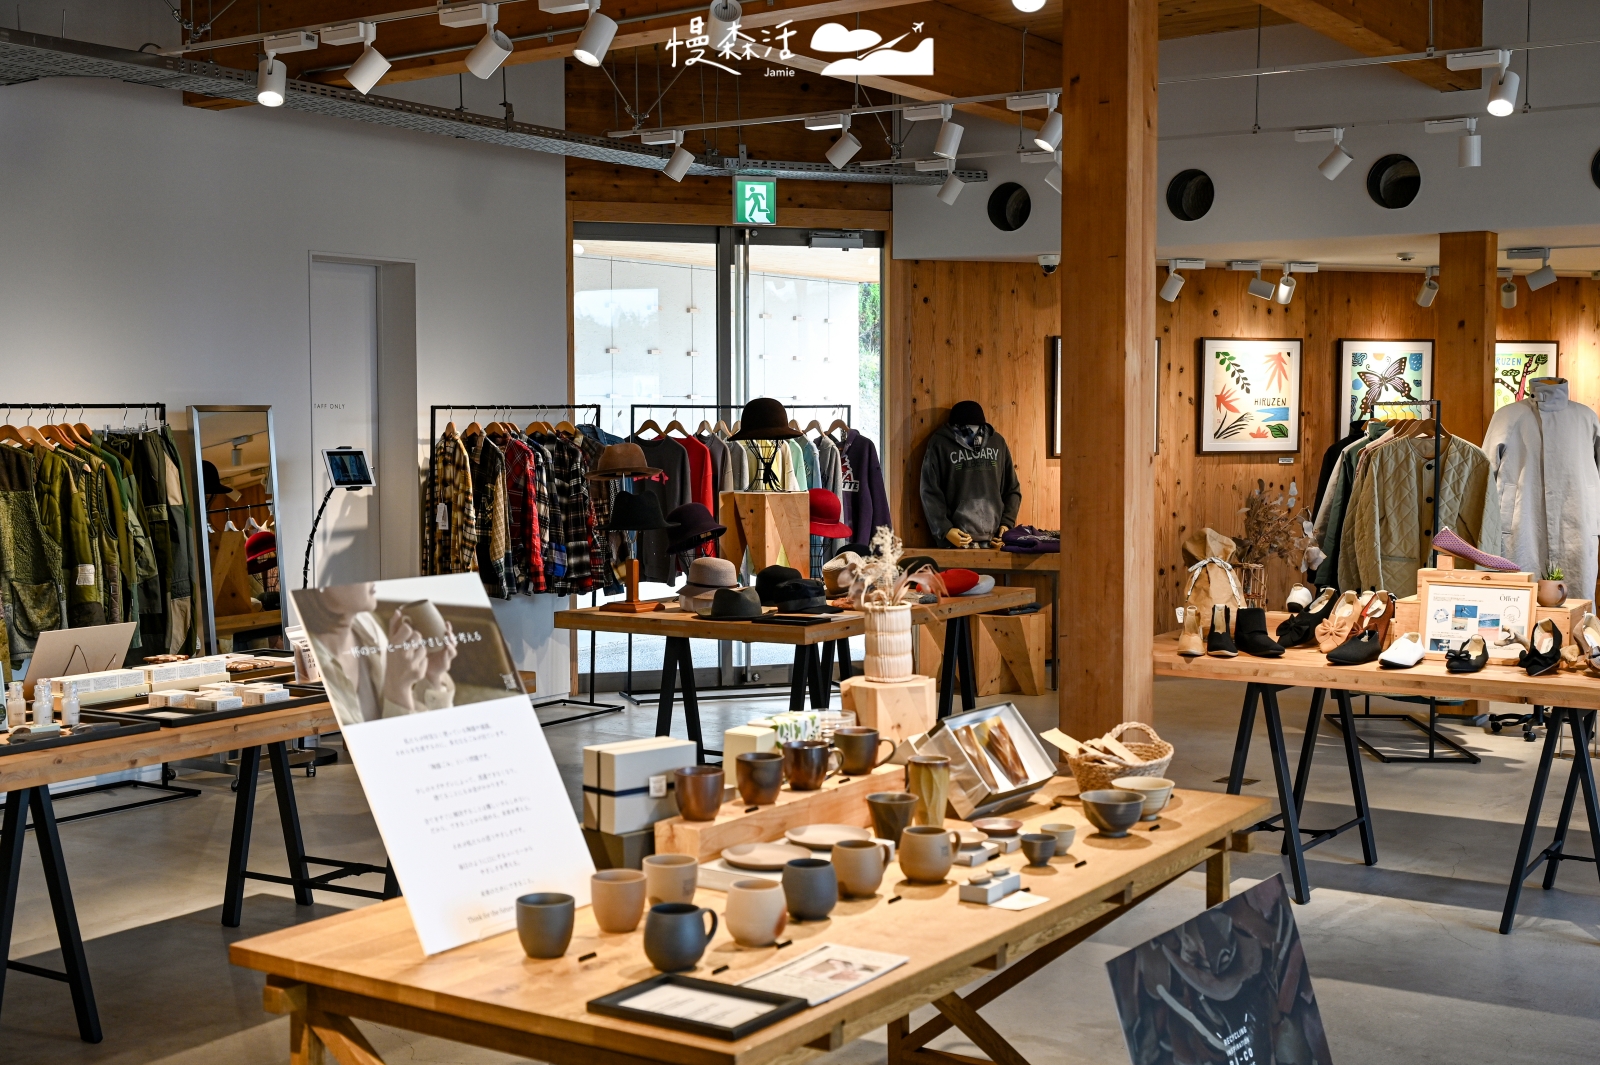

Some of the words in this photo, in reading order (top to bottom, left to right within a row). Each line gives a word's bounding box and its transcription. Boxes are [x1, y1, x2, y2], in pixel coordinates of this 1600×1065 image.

[1254, 397, 1287, 407] HIRUZEN
[949, 447, 999, 464] CALGARY
[1223, 1026, 1248, 1047] RECYCLING
